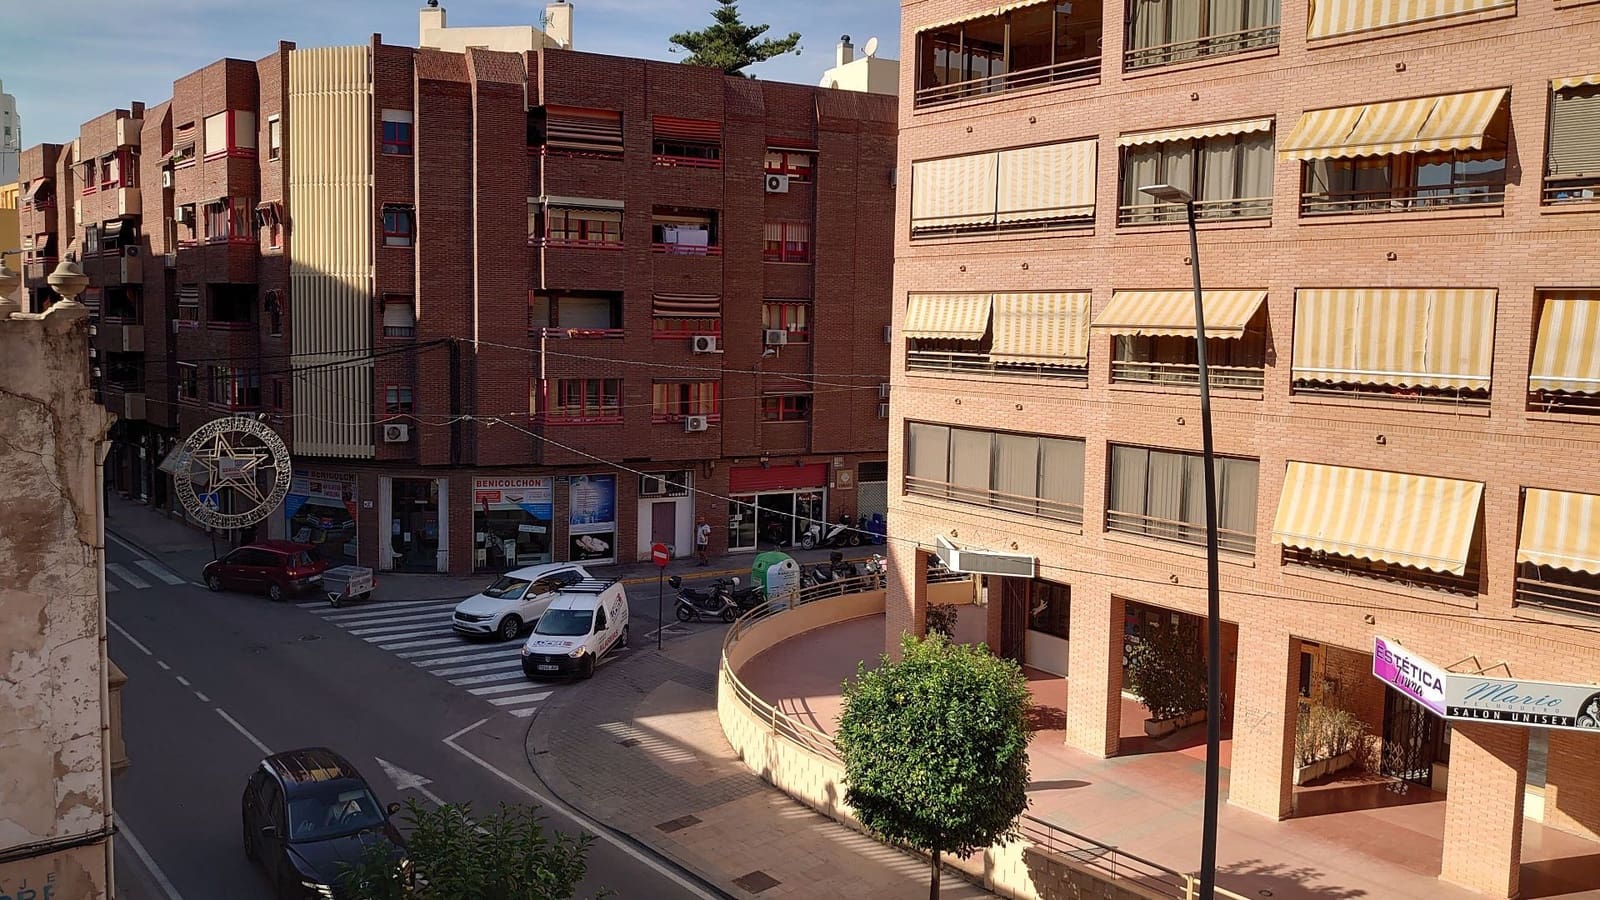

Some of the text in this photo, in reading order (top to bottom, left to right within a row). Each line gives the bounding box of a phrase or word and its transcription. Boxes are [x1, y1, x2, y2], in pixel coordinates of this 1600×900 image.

[476, 479, 541, 488] BENICOLCHON
[1377, 645, 1443, 694] ESTÉTICA
[1392, 666, 1424, 697] Inma
[1464, 682, 1563, 707] Mario
[1453, 708, 1568, 725] SALON UNISEX
[1463, 701, 1560, 714] PELUQUERO
